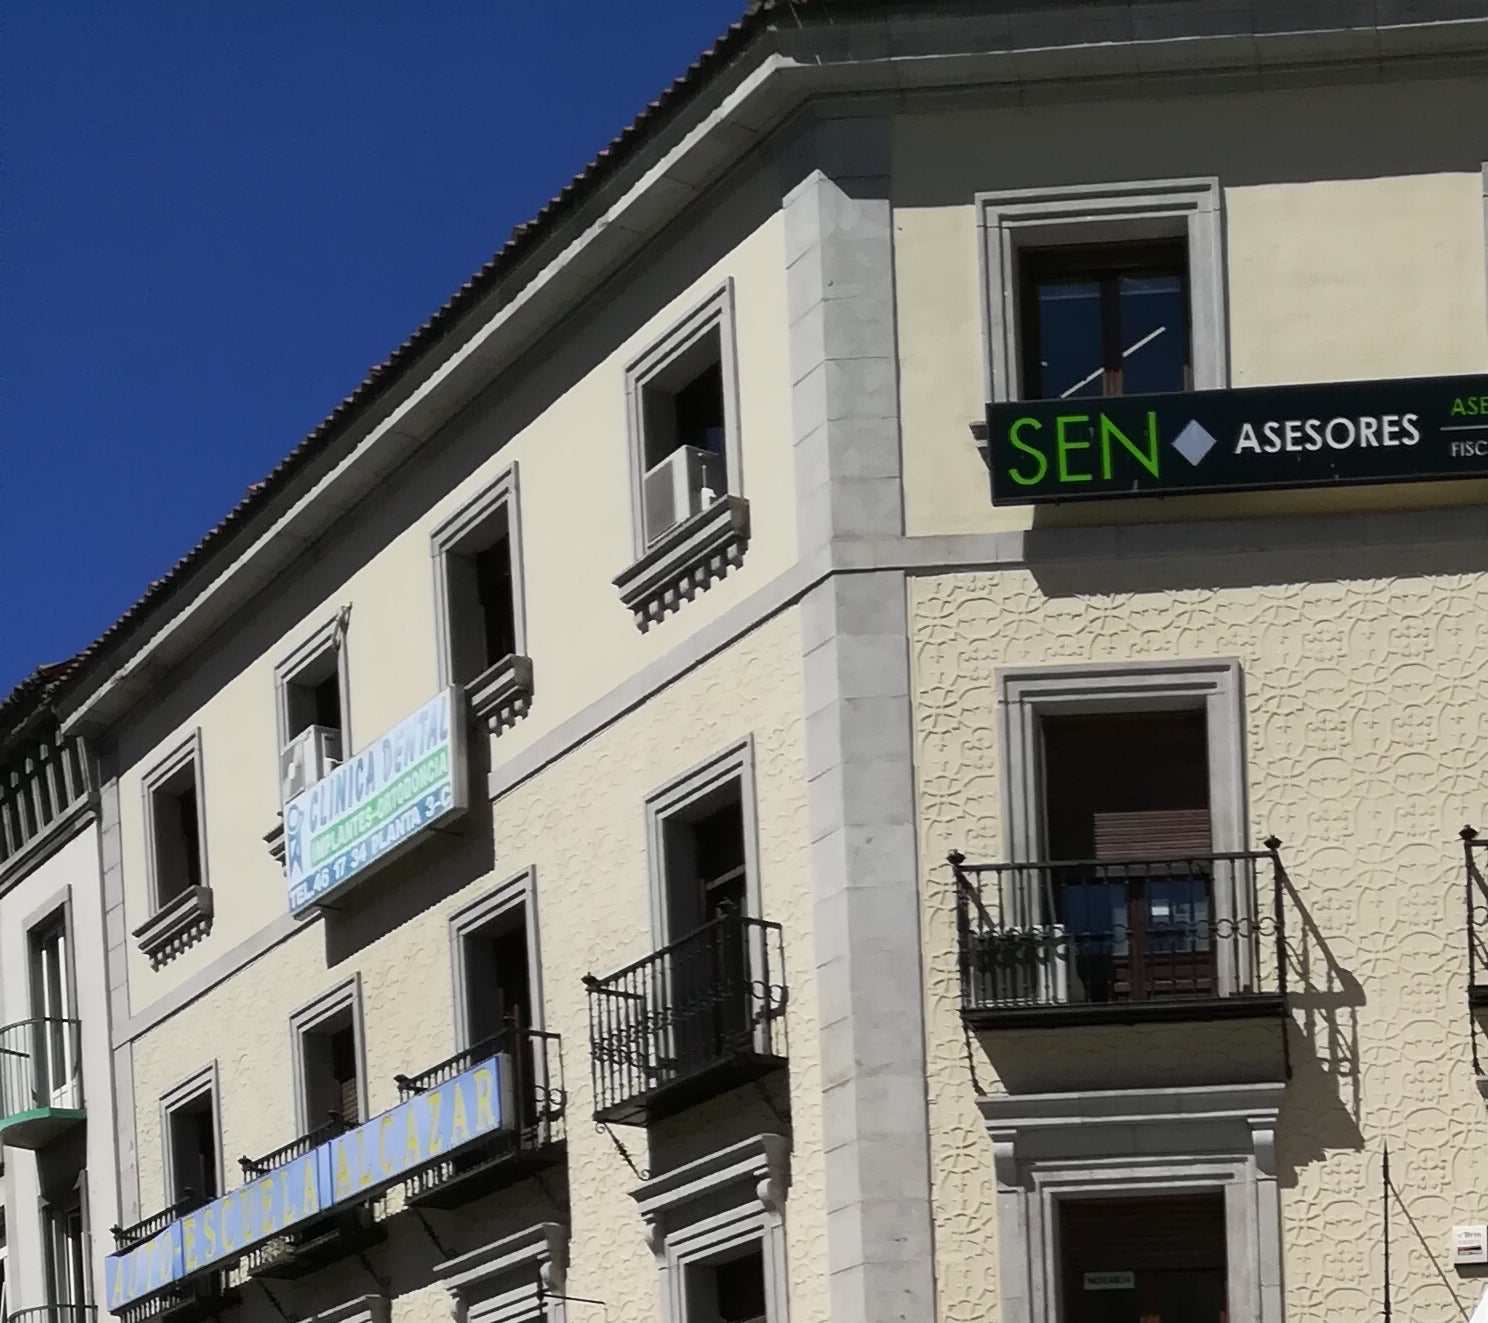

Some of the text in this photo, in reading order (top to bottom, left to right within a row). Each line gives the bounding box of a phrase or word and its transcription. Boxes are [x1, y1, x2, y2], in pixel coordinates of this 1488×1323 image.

[1008, 411, 1421, 486] SEN ASESORES
[309, 696, 449, 834] CLINICA DENTAL
[312, 751, 448, 864] IMPLANTES-ORTODONCIA
[371, 806, 422, 855] PLANTA
